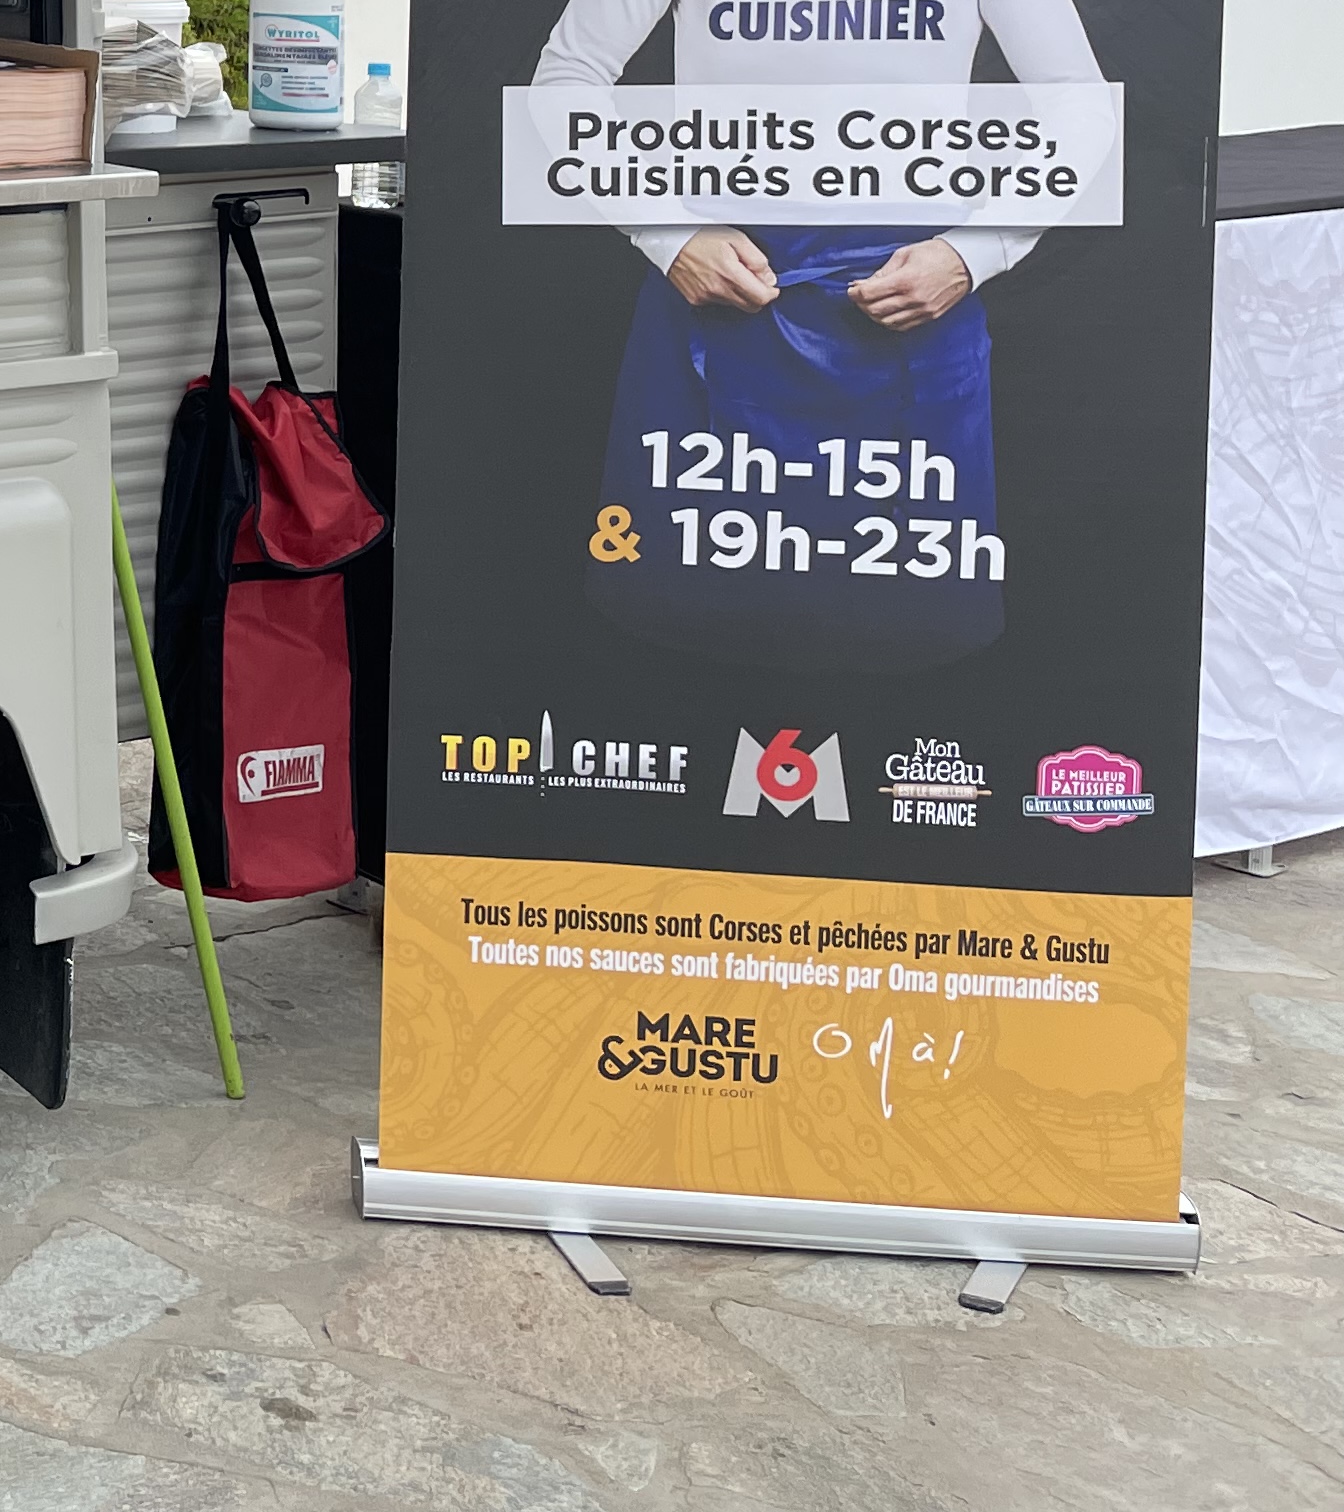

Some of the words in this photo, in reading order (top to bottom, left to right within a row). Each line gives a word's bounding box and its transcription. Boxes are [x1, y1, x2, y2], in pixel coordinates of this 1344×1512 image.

[267, 28, 321, 39] WYRITOL
[709, 0, 945, 42] CUISINIER
[568, 108, 813, 151] Produits
[837, 109, 1058, 159] Corses,
[546, 154, 791, 198] Cuisinés
[812, 163, 880, 198] en
[902, 156, 1079, 198] Corse
[640, 430, 956, 502] 12h-15h
[588, 504, 642, 563] &
[670, 507, 1006, 581] 19h-23h
[441, 734, 531, 774] TOP
[572, 739, 688, 782] CHEF
[914, 737, 961, 758] Mon
[264, 755, 315, 788] FIAMMA
[442, 771, 461, 782] LES
[463, 772, 535, 787] RESTAURANTS
[548, 775, 566, 787] LES
[568, 776, 593, 788] PLUS
[594, 777, 687, 794] EXTRAORDINAIRES
[885, 753, 986, 786] Gâteau
[1052, 768, 1065, 780] LE
[1069, 770, 1126, 782] MEILLEUR
[892, 799, 914, 823] DE
[916, 801, 977, 827] FRANCE
[1025, 797, 1071, 813] GÂTEAUX
[1072, 799, 1094, 812] SUR
[1096, 798, 1152, 812] COMMANDE
[461, 898, 511, 927] Tous
[518, 901, 548, 928] les
[554, 904, 648, 935] poissons
[654, 913, 702, 939] sont
[709, 913, 782, 945] Corses
[789, 921, 811, 946] et
[818, 920, 908, 953] pêchées
[914, 927, 951, 960] par
[957, 929, 1013, 960] Mare
[1020, 934, 1038, 961] &
[1046, 935, 1110, 965] Gustu
[468, 935, 539, 967] Toutes
[545, 945, 584, 969] nos
[589, 947, 664, 975] sauces
[671, 952, 719, 979] sont
[725, 951, 840, 990] fabriquées
[846, 963, 882, 994] par
[888, 962, 938, 994] Oma
[944, 973, 1100, 1004] gourmandises
[636, 1010, 756, 1049] MARE
[635, 1082, 649, 1091] LA
[654, 1083, 678, 1094] MER
[684, 1085, 697, 1095] ET
[702, 1087, 714, 1096] LE
